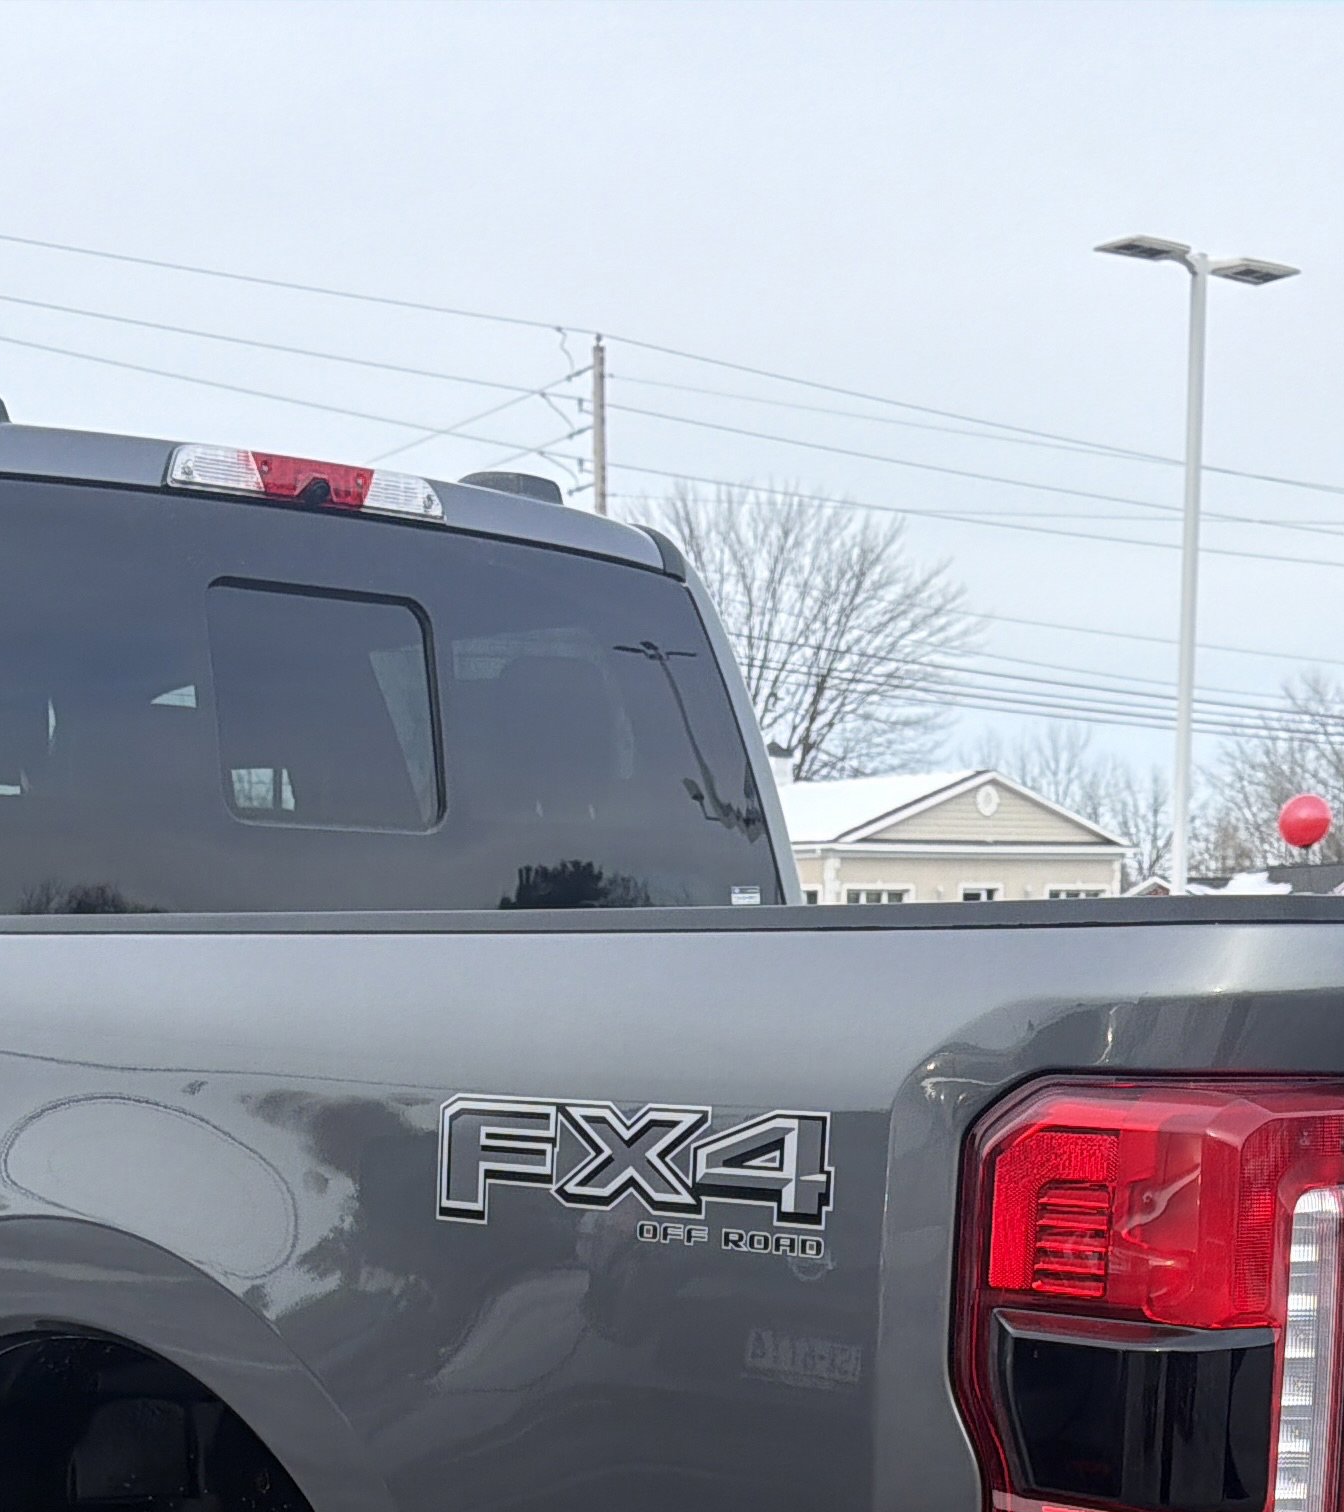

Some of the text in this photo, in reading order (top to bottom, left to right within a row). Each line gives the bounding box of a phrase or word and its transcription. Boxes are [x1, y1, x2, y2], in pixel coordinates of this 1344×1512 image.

[436, 1093, 834, 1229] FX4
[637, 1221, 824, 1259] OFF ROAD
